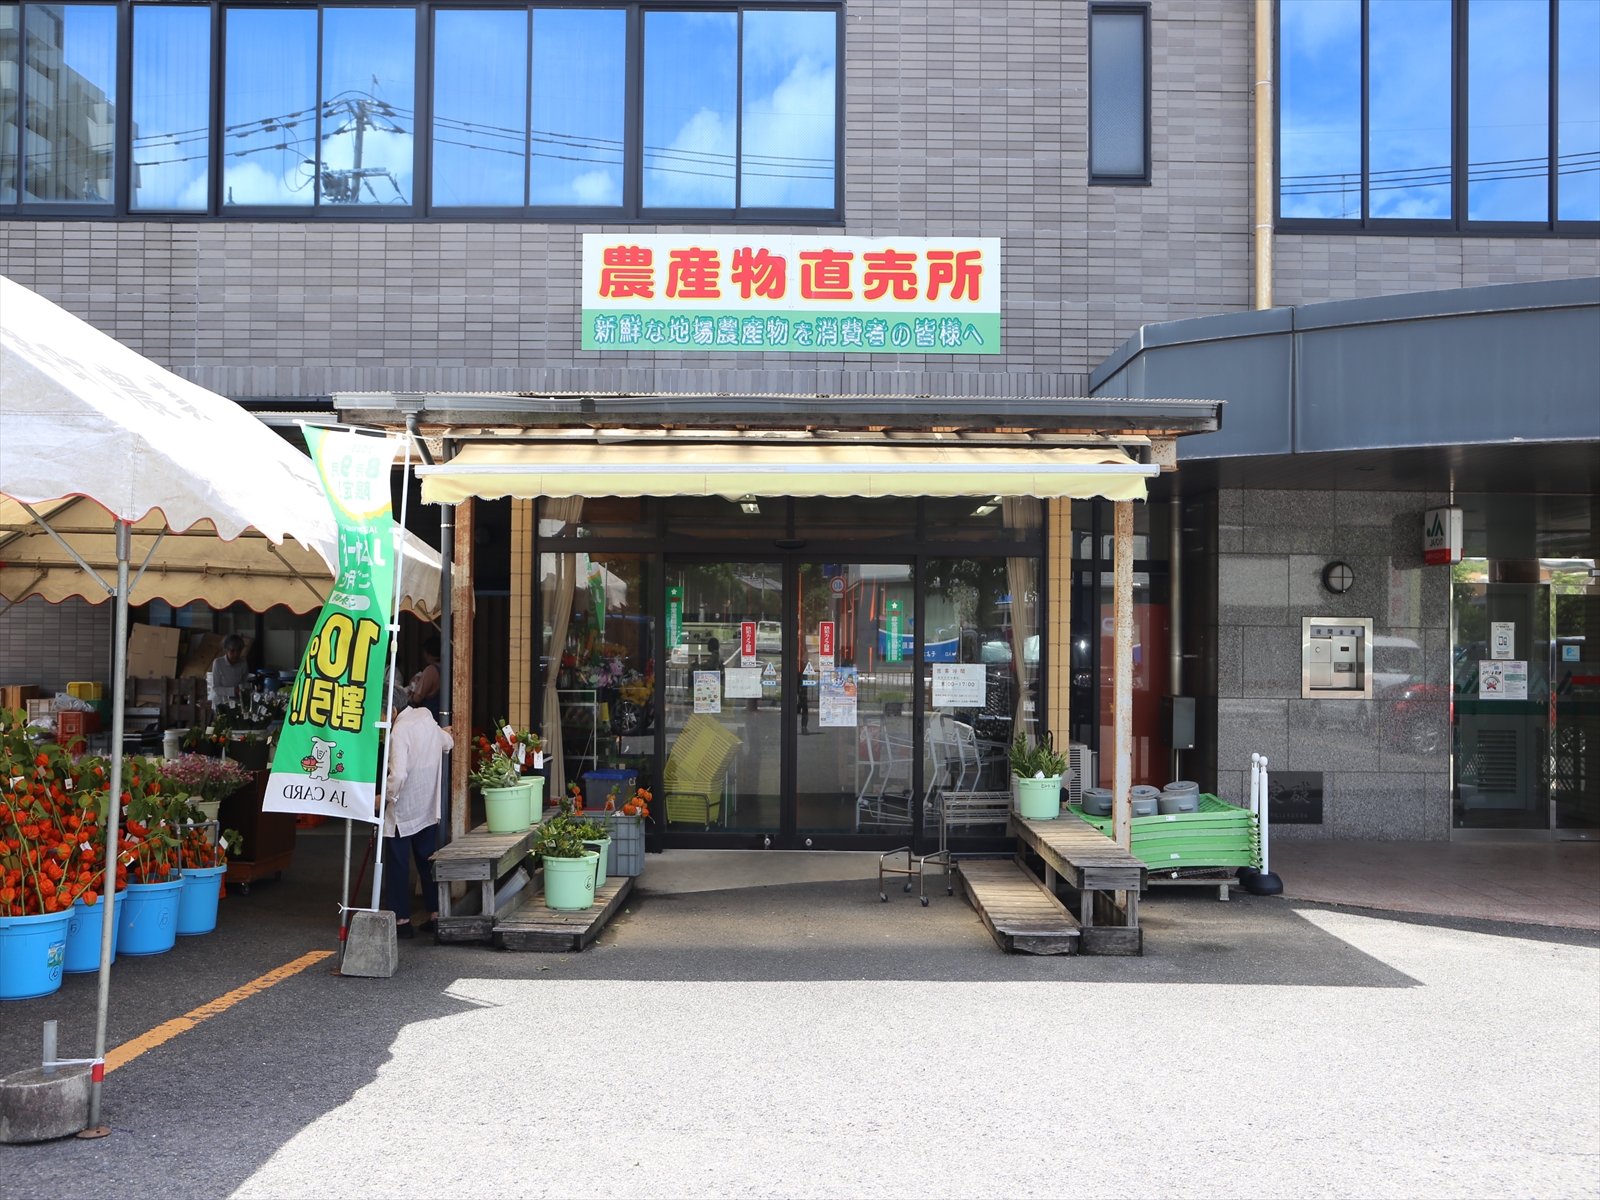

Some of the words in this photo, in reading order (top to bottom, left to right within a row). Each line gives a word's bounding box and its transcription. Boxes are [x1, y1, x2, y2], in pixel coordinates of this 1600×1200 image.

[597, 245, 984, 303] 農産物直売所
[593, 314, 985, 349] 新鮮な地場農産物を消費者の皆様へ
